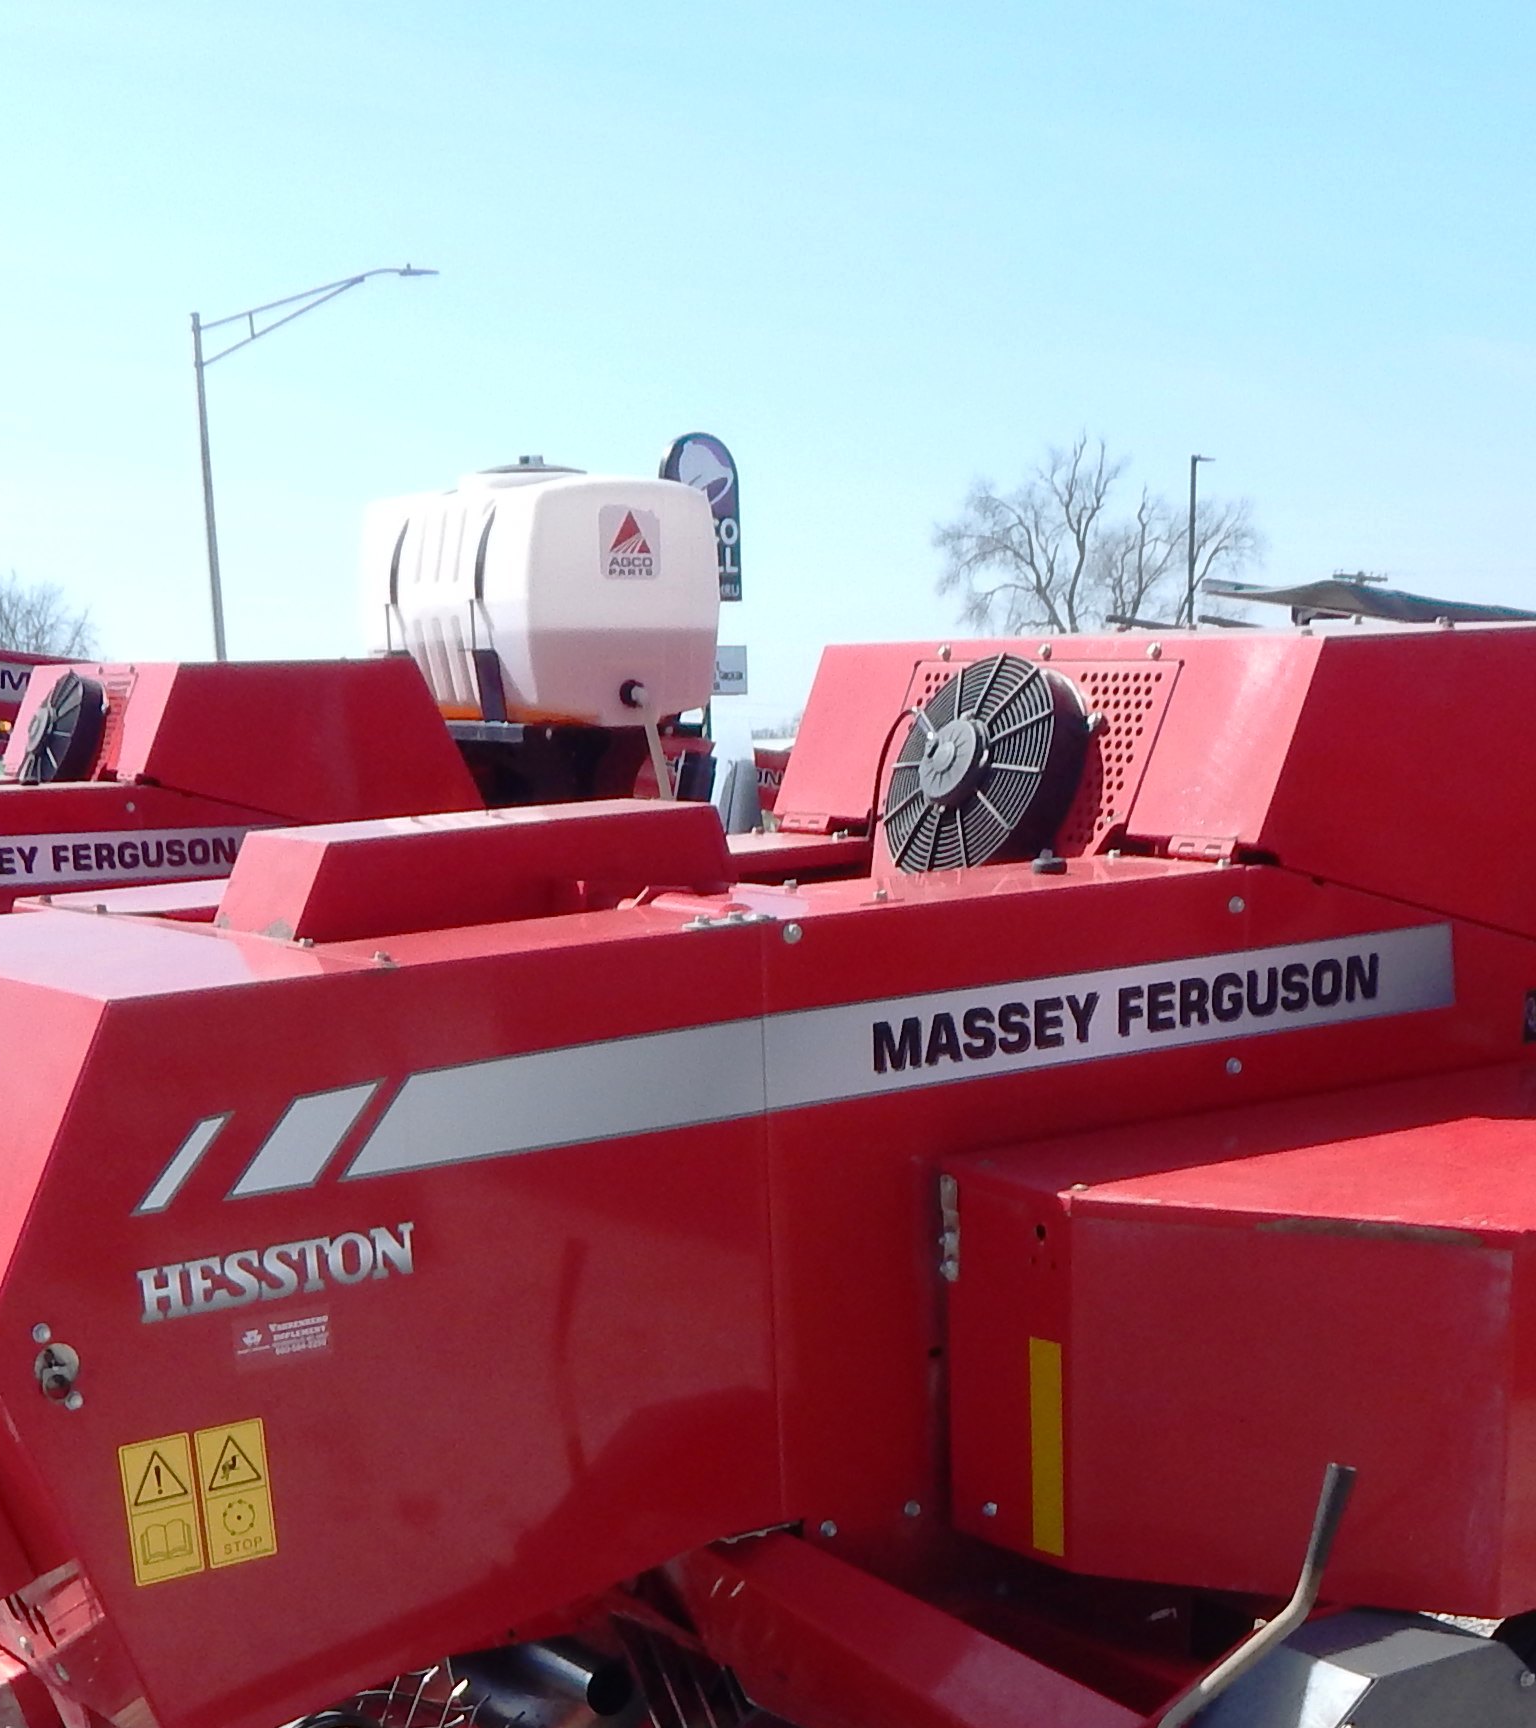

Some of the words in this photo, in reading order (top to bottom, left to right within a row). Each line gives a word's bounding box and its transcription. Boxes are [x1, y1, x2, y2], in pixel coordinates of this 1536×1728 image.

[608, 568, 653, 576] PARTS
[609, 556, 653, 568] AGCO
[51, 836, 236, 873] FERGUSON
[872, 992, 1100, 1074] MASSEY
[1117, 952, 1379, 1038] FERGUSON
[135, 1221, 415, 1325] HESSTON
[223, 1535, 264, 1556] STOP
